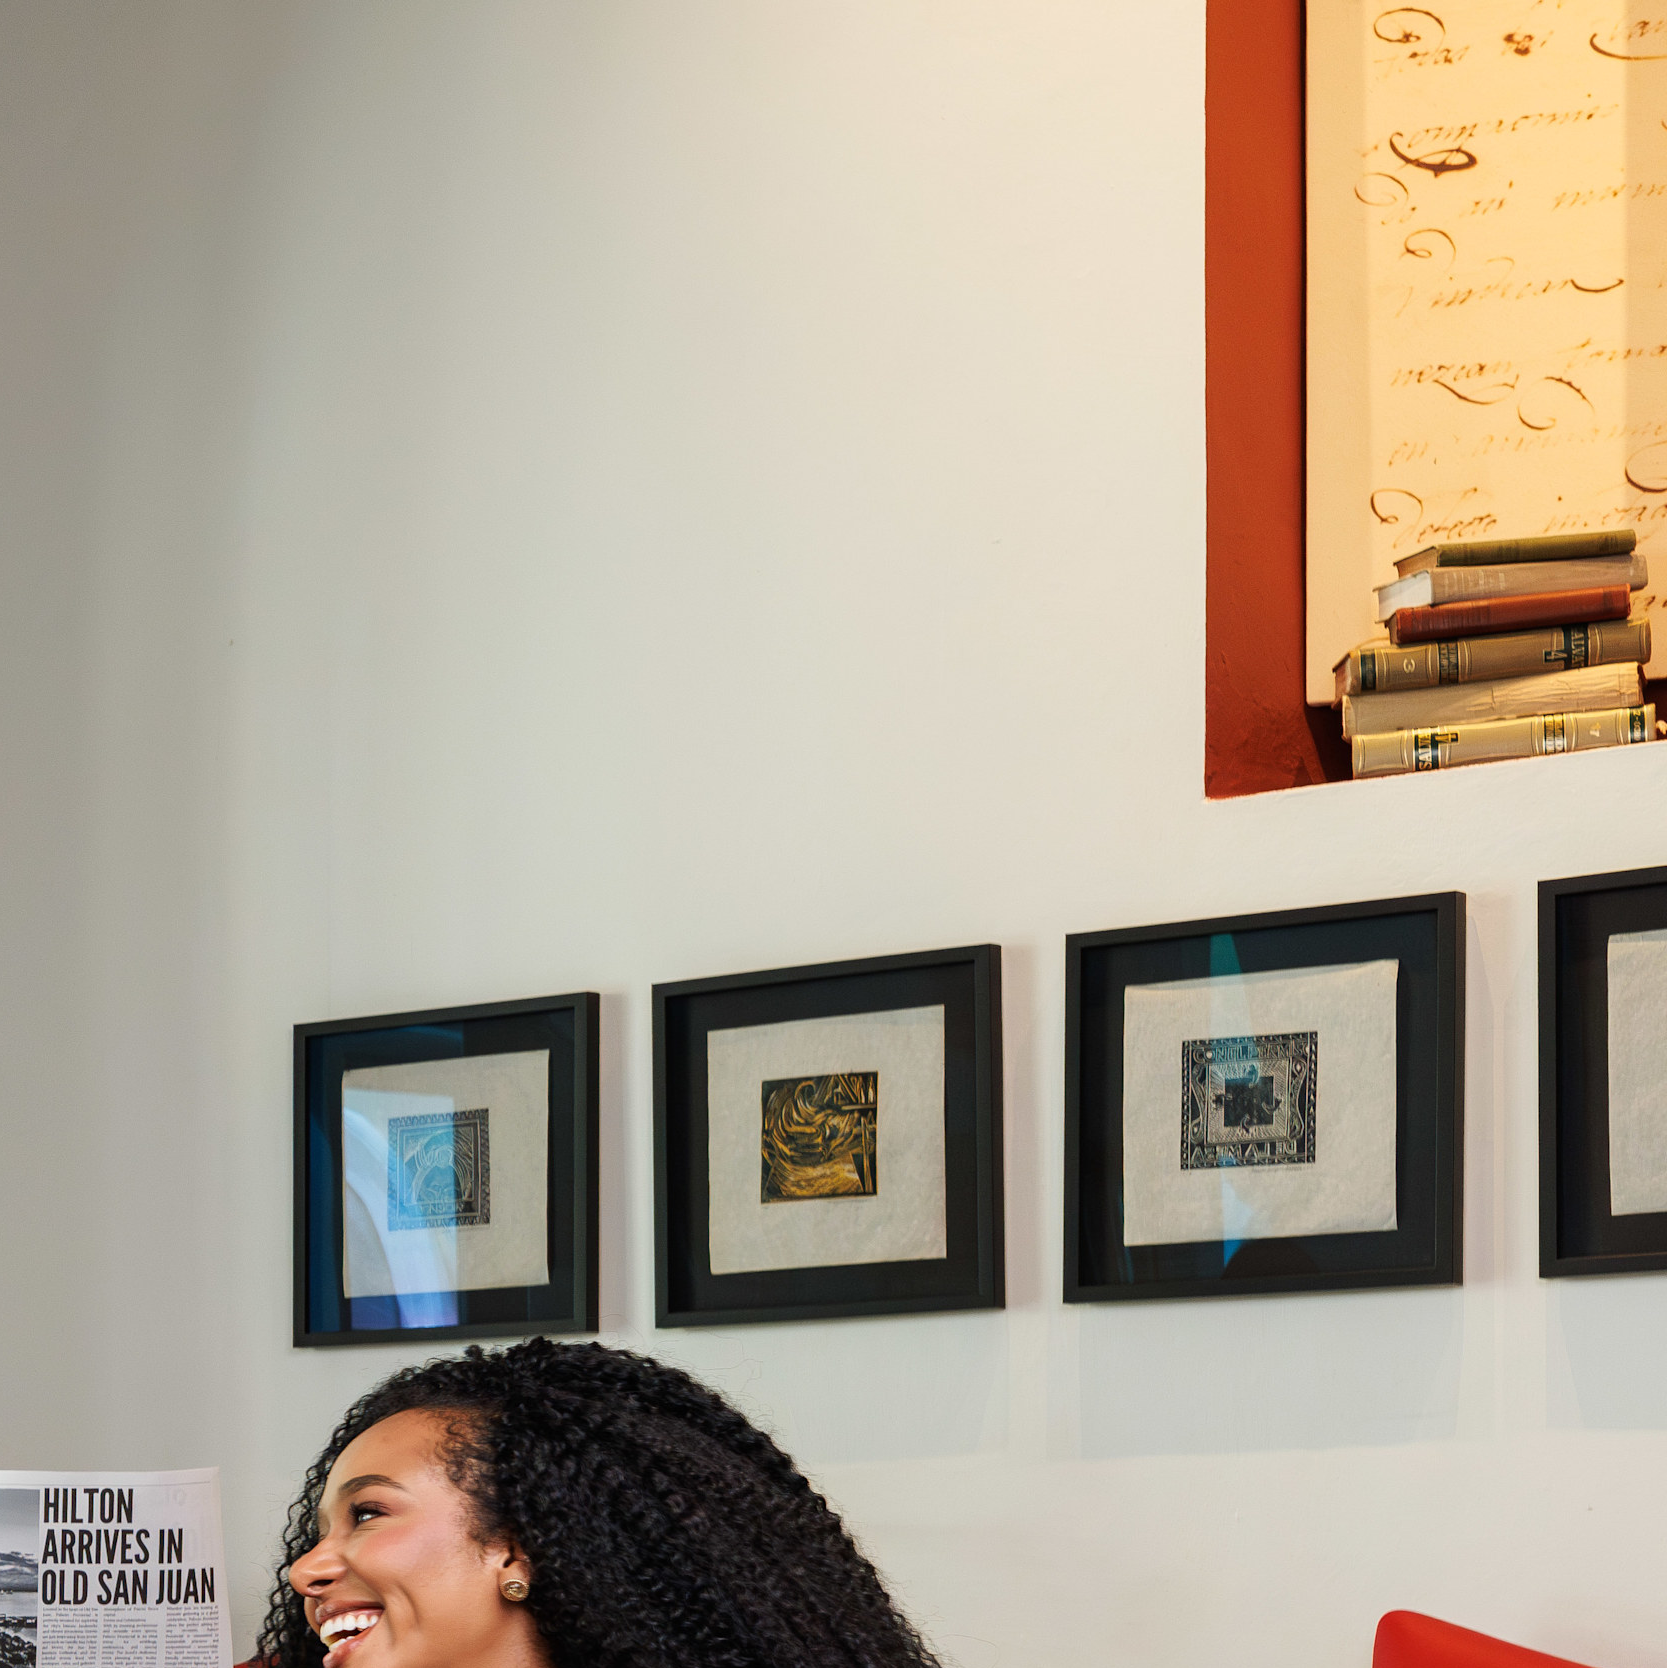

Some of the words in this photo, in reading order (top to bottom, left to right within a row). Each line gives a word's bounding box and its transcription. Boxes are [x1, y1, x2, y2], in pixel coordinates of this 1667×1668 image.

[43, 1487, 134, 1524] HILTON
[41, 1528, 150, 1565] ARRIVES
[158, 1528, 184, 1564] IN
[40, 1569, 88, 1606] OLD
[97, 1569, 148, 1606] SAN
[155, 1566, 216, 1605] JUAN
